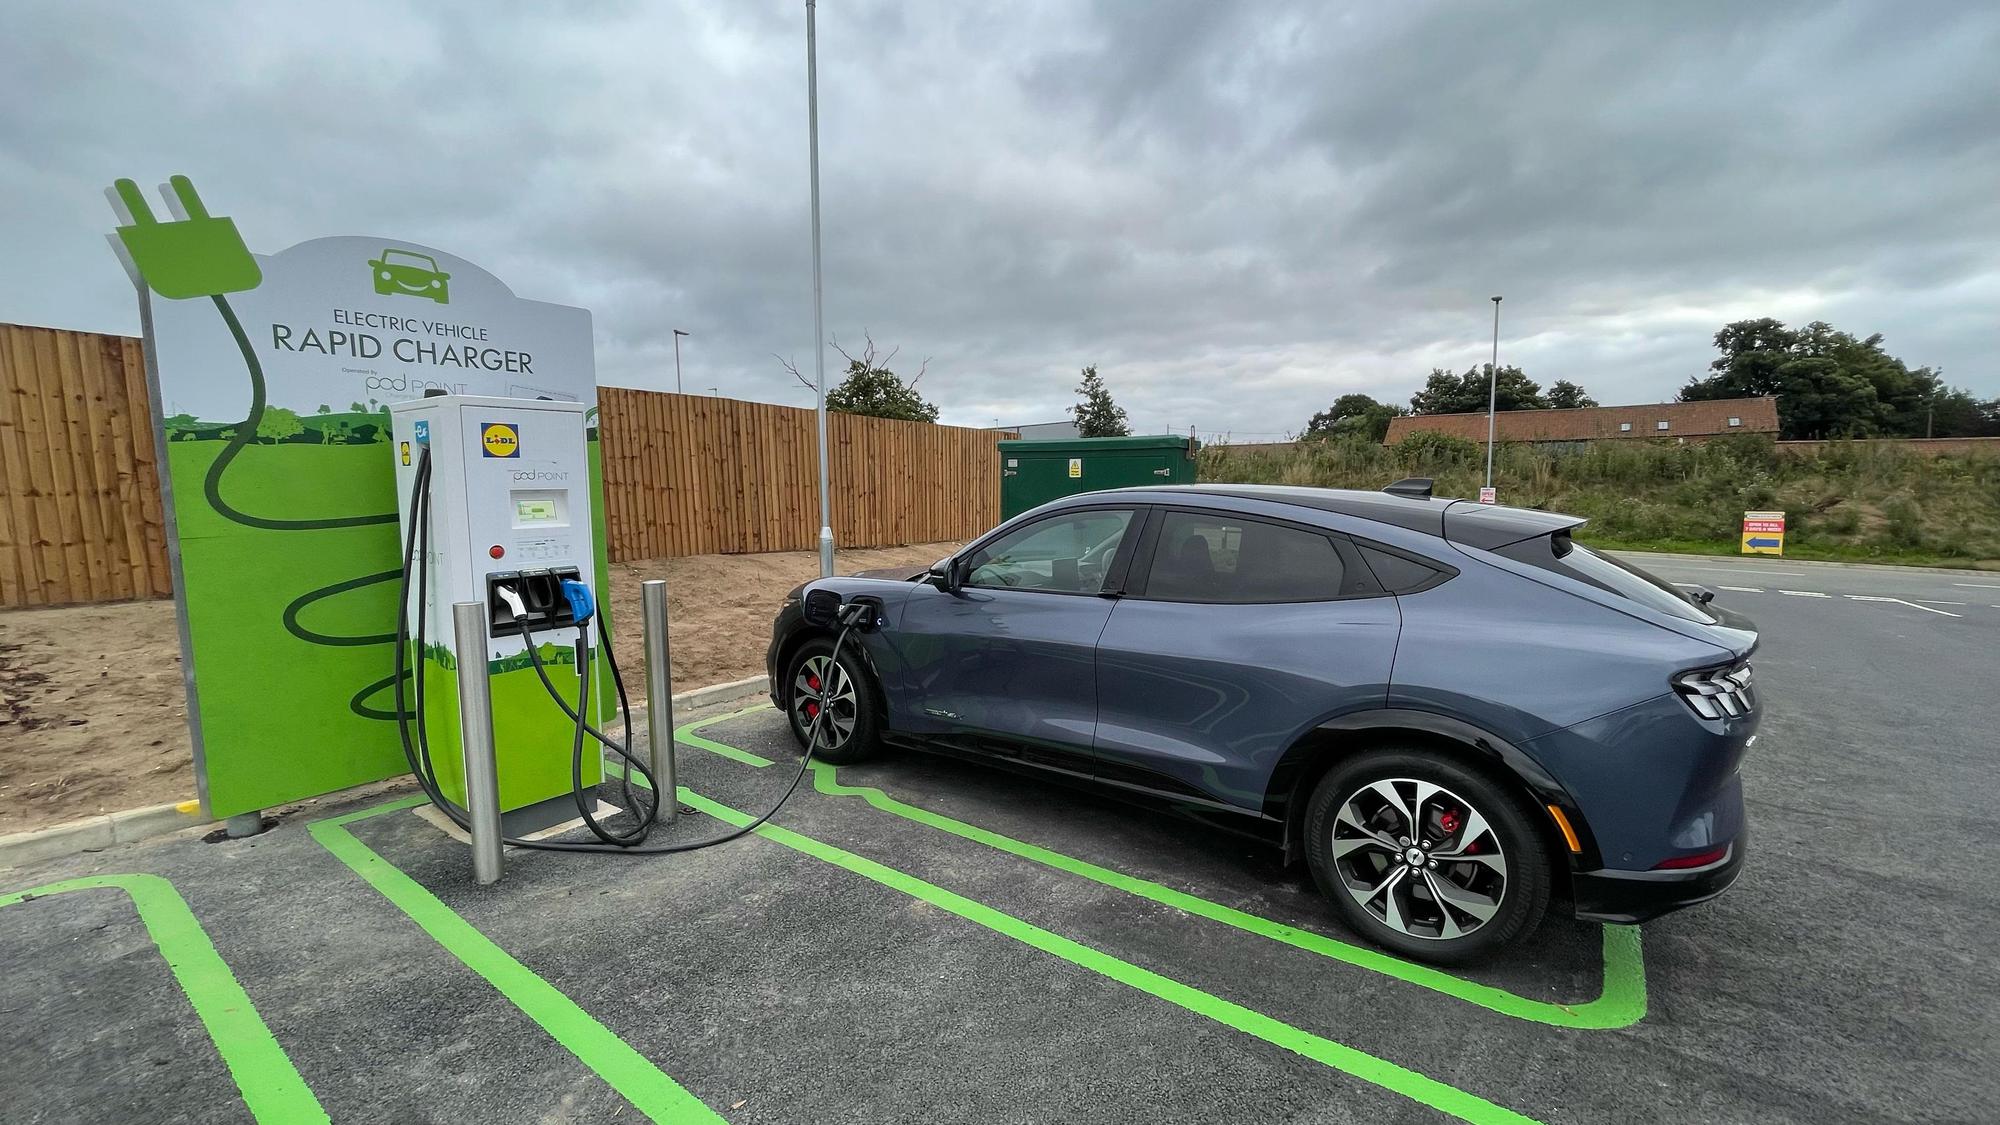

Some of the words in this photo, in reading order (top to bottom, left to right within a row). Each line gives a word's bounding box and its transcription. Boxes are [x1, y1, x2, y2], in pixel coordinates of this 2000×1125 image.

[334, 309, 418, 333] ELECTRIC
[422, 320, 488, 341] VEHICLE
[272, 323, 382, 359] RAPID
[393, 338, 534, 374] CHARGER
[341, 367, 369, 375] Operated
[365, 373, 406, 395] pod
[513, 468, 535, 484] pod
[537, 472, 569, 481] POINT
